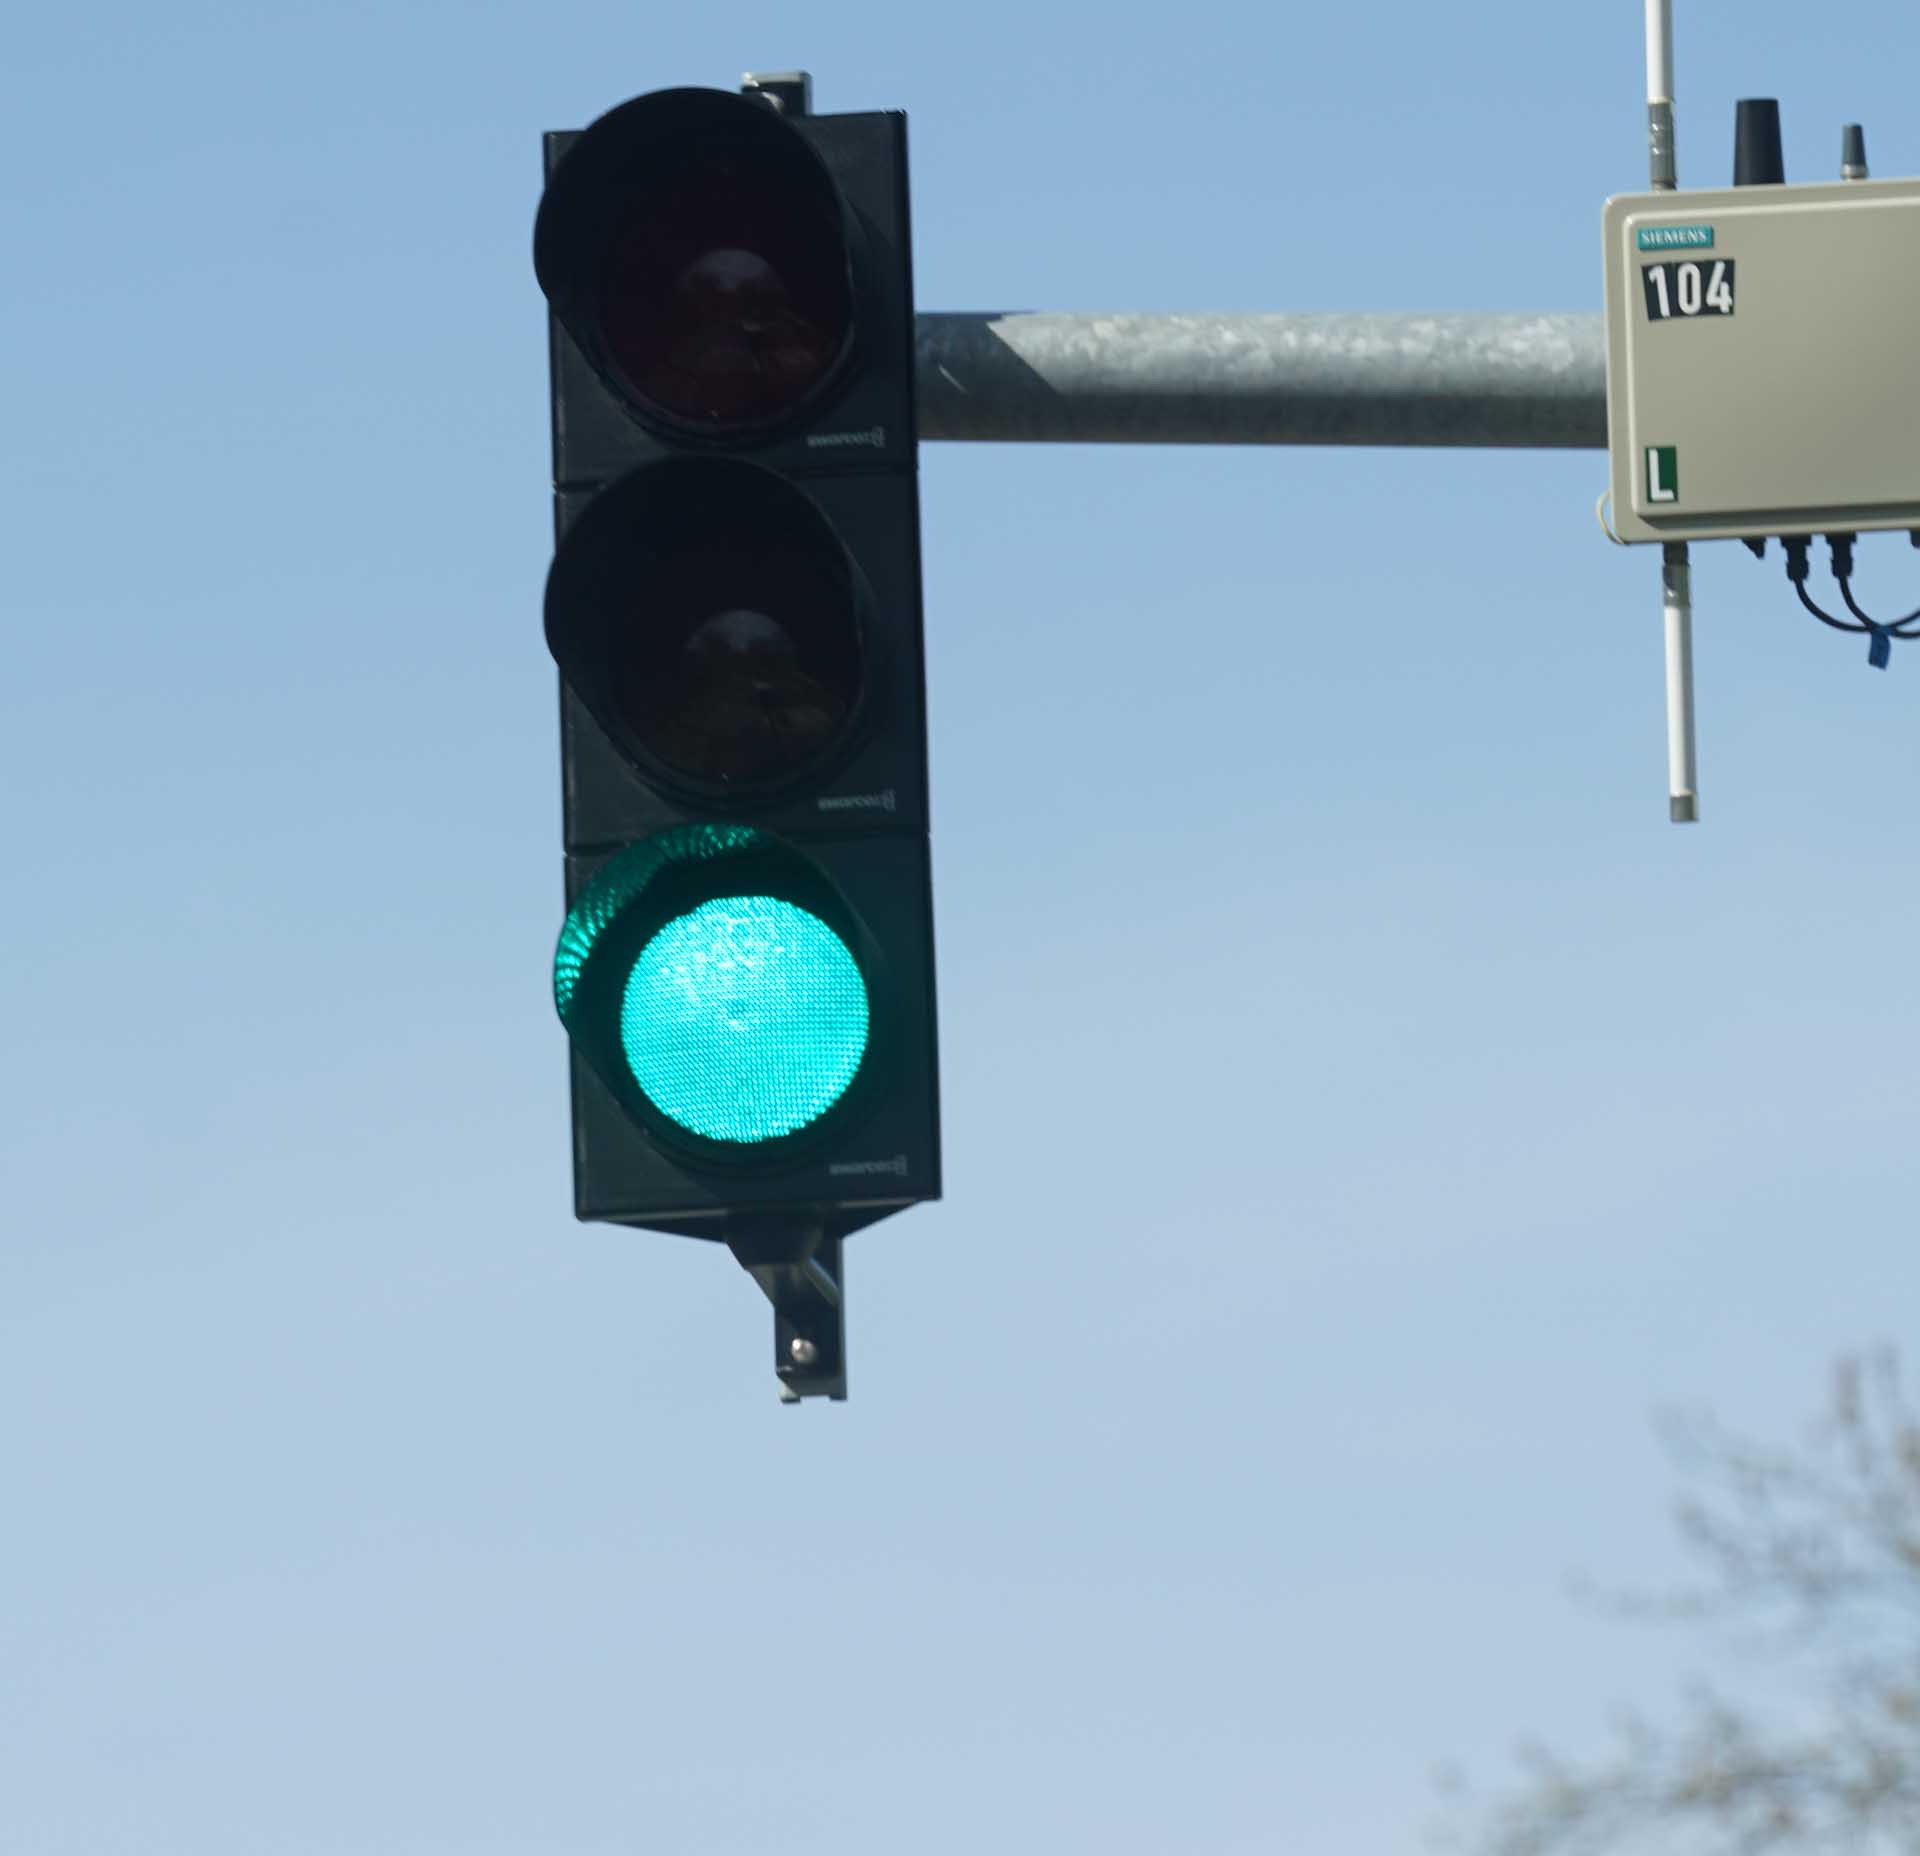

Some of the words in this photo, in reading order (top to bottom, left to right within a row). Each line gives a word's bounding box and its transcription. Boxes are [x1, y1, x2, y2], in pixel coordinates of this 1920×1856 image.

[1641, 229, 1707, 244] SIEMENS
[1648, 261, 1733, 317] 104
[1648, 448, 1675, 501] L
